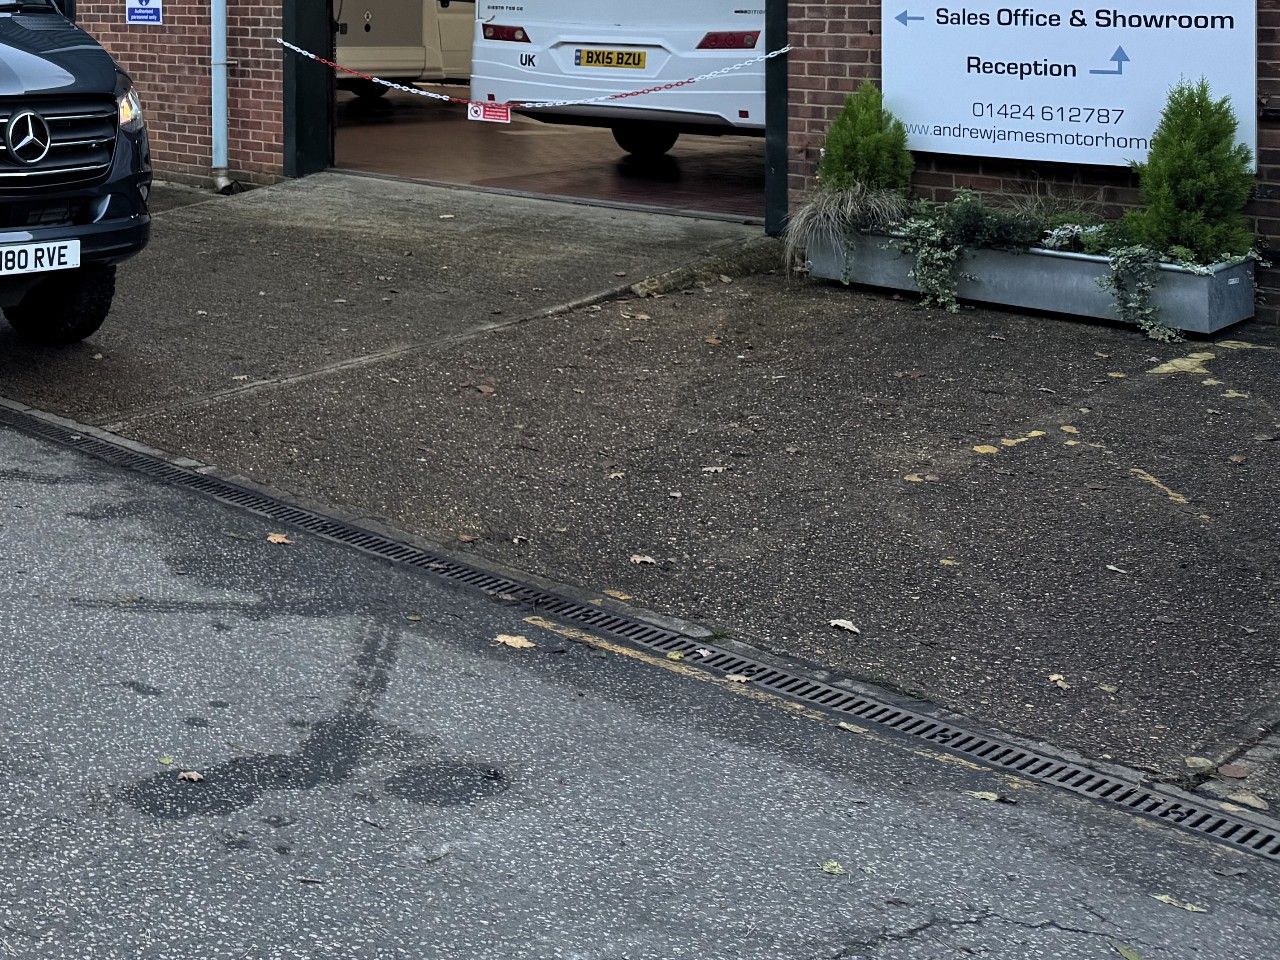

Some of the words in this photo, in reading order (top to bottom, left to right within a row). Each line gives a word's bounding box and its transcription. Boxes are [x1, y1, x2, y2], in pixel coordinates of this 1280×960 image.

[936, 7, 990, 26] Sales
[996, 8, 1061, 27] Office
[1069, 9, 1088, 28] &
[1095, 9, 1235, 29] Showroom
[520, 53, 536, 67] UK
[586, 51, 613, 64] BX15
[616, 52, 641, 66] BZU
[967, 56, 1077, 80] Reception
[972, 102, 1035, 121] 01424
[1041, 106, 1125, 125] 612787
[904, 123, 1153, 150] ww.andrewjamesmotorhom
[34, 245, 68, 269] RVE
